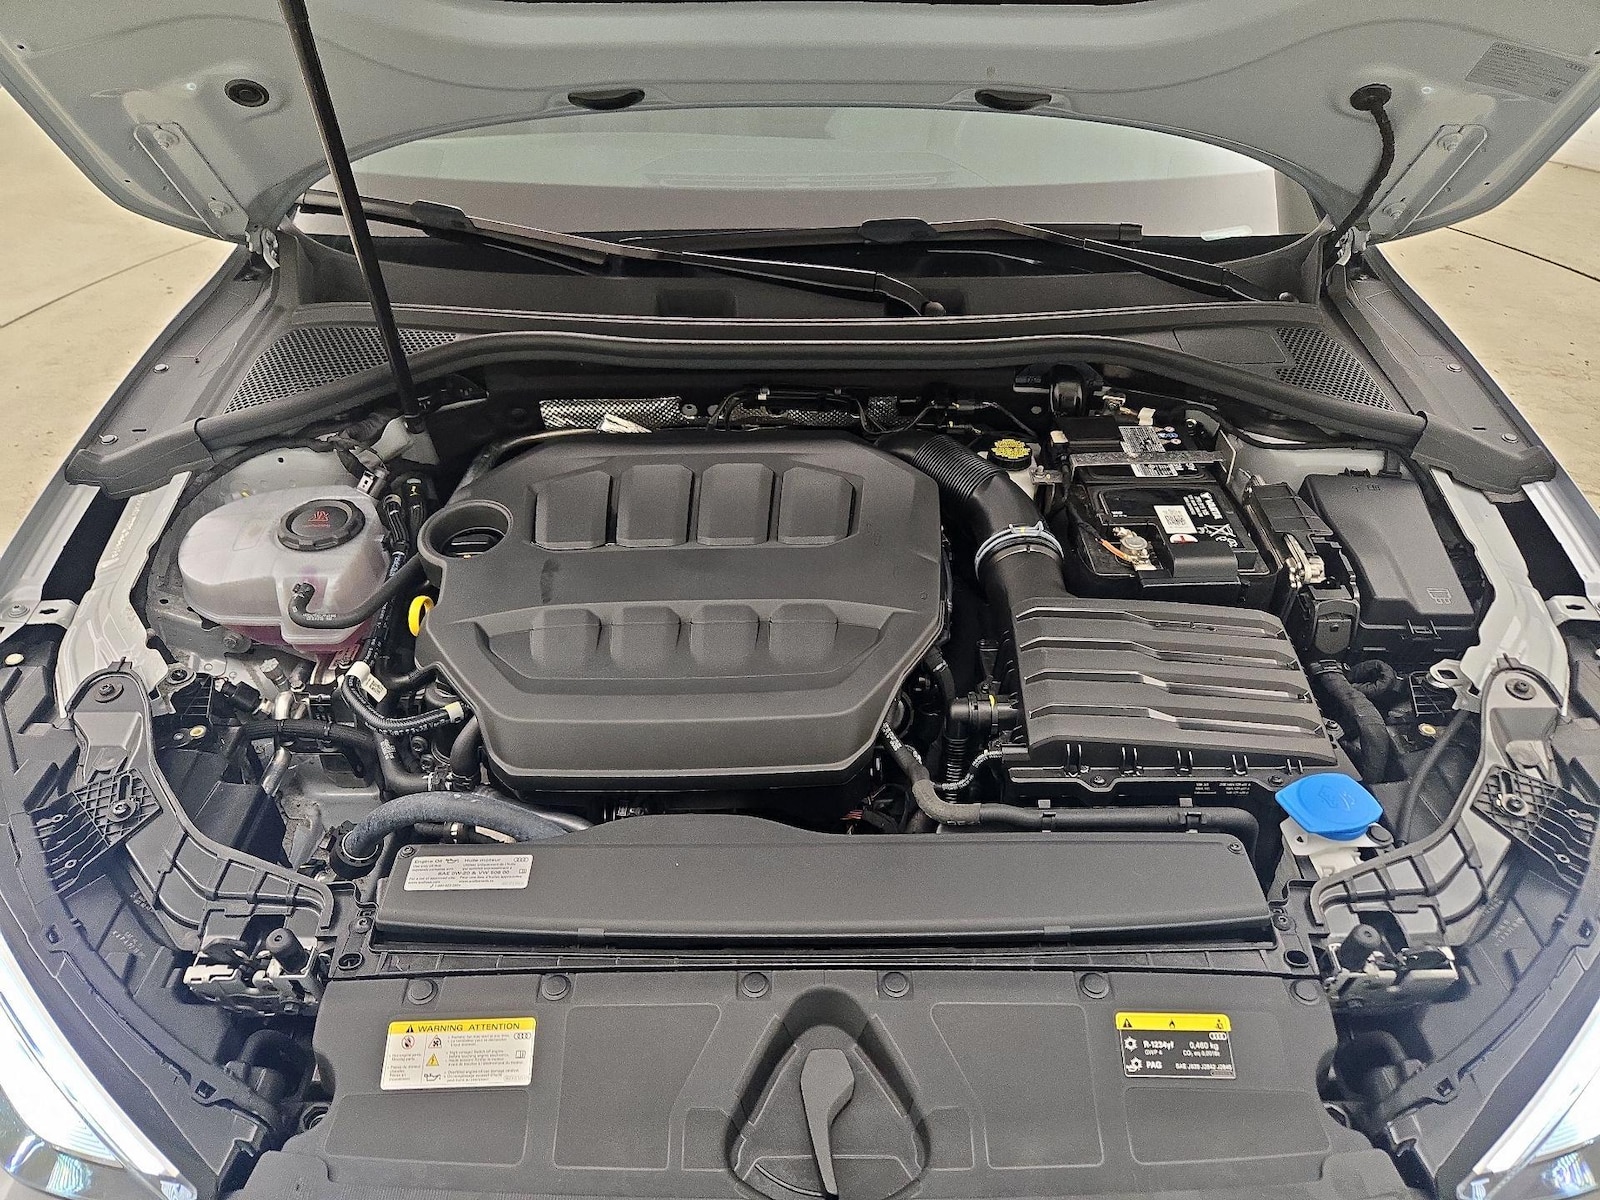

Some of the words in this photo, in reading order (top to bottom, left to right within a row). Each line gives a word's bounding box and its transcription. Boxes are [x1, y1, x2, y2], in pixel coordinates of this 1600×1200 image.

[418, 1025, 463, 1033] WARNING
[467, 1023, 520, 1031] ATTENTION
[1143, 1040, 1174, 1050] R-1234yf
[1209, 1041, 1219, 1051] kg
[1145, 1060, 1163, 1069] PAG
